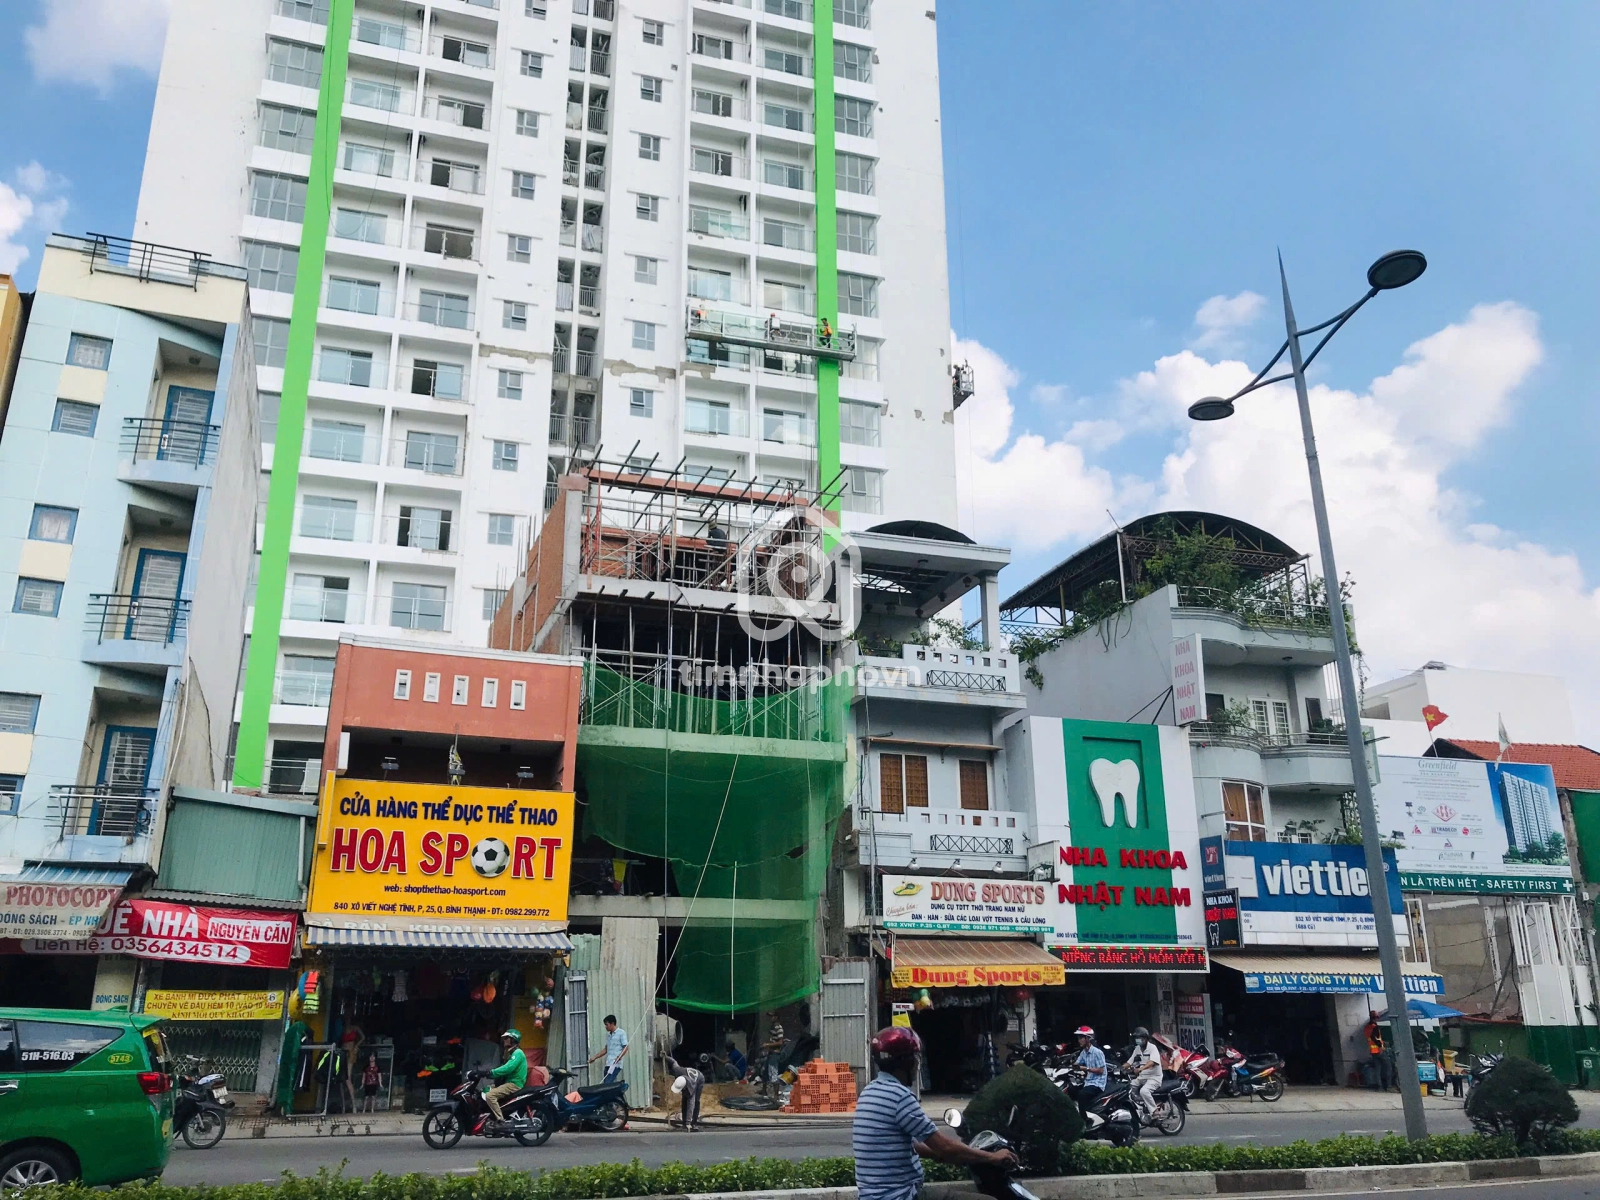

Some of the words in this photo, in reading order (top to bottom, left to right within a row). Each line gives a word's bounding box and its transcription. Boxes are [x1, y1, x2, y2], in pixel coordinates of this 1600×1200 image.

[1174, 640, 1191, 657] NHA
[1174, 660, 1195, 678] KHOA
[1176, 680, 1196, 700] NHẬT
[1179, 704, 1196, 721] NAM
[339, 790, 371, 816] CỬA
[376, 795, 418, 820] HÀNG
[421, 795, 453, 821] THỂ
[452, 804, 484, 826] DỤC
[486, 799, 519, 824] THỂ
[519, 807, 558, 826] THAO
[330, 827, 408, 874] HOA
[1059, 845, 1109, 868] NHA
[1120, 848, 1189, 871] KHOA
[1262, 858, 1372, 897] viettie
[1410, 874, 1424, 887] LÀ
[1426, 876, 1455, 888] TRÊN
[1486, 880, 1526, 890] SAFETY
[1529, 880, 1558, 891] FIRST
[5, 885, 121, 909] PHOTOCOPY
[384, 882, 403, 894] web:
[403, 883, 506, 897] shopthethao-hoasport.com
[981, 883, 1045, 905] SPORTS
[1057, 880, 1125, 911] NHẬT
[1134, 885, 1192, 908] NAM
[29, 911, 57, 926] SÁCH
[333, 902, 349, 910] 840
[350, 901, 361, 911] XÔ
[362, 901, 377, 911] VIẾT
[378, 903, 397, 914] NGHỆ
[445, 904, 462, 914] BÌNH
[463, 906, 486, 917] THẠNH
[504, 908, 550, 917] 0982.299.772
[956, 913, 968, 922] CÁC
[985, 904, 1003, 912] TRANG
[1004, 905, 1016, 913] NAM
[141, 905, 199, 939] NHÀ
[208, 921, 260, 941] NGUYÊN
[76, 938, 105, 953] Hệ:
[111, 936, 238, 960] 0356434514
[973, 966, 1042, 986] Sports
[1264, 974, 1283, 987] ĐẠI
[1286, 973, 1298, 985] LÝ
[1300, 973, 1332, 985] CÔNG
[1334, 975, 1348, 985] TY
[1349, 975, 1372, 986] MAY
[1373, 974, 1438, 993] Vttien
[225, 1001, 235, 1009] 10
[21, 1051, 75, 1062] 51H-516.03
